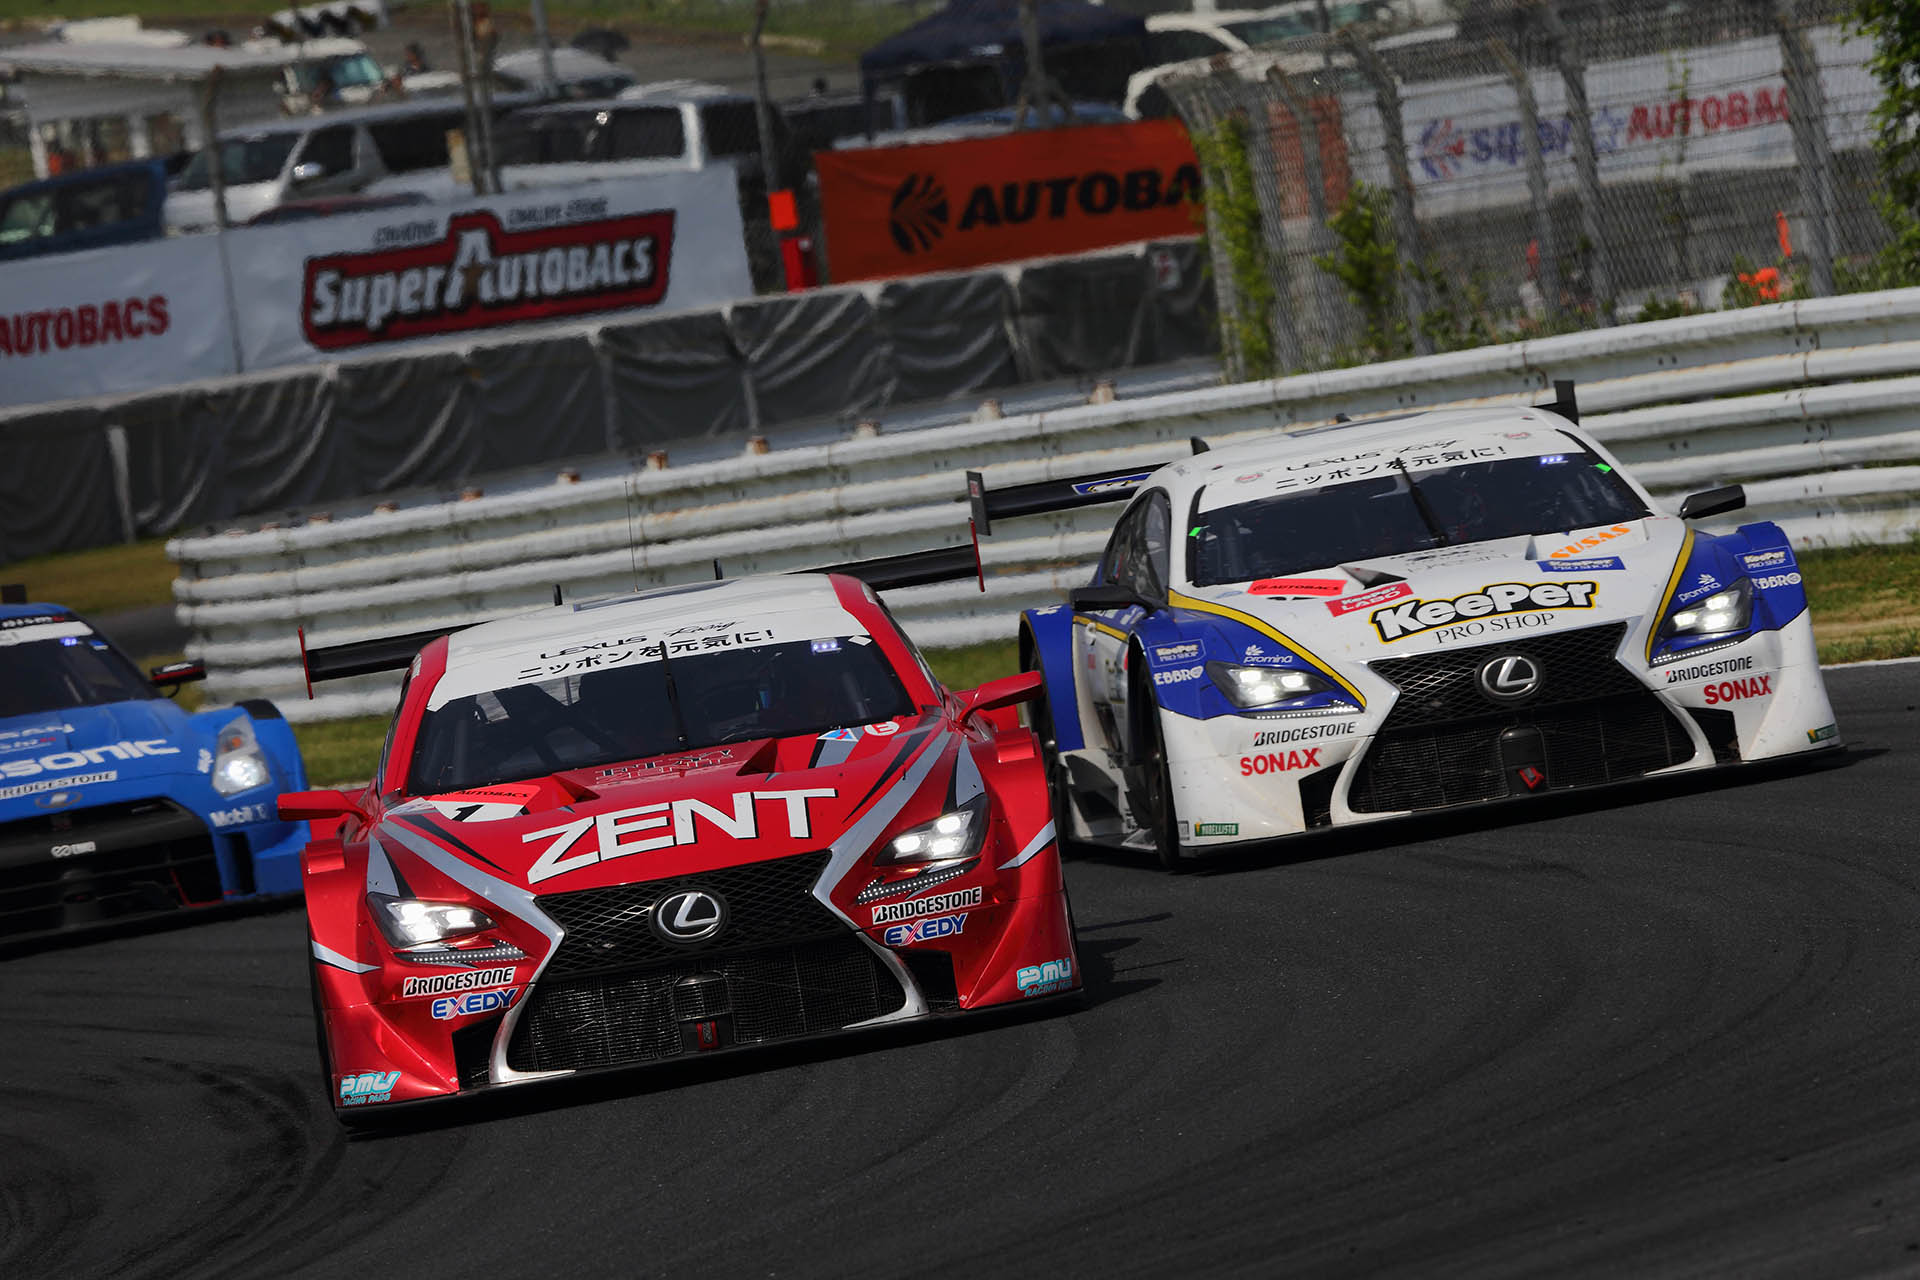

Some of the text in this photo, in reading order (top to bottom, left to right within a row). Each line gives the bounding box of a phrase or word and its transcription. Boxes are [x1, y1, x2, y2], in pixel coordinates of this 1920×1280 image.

[1678, 582, 1722, 602] promina
[1374, 582, 1595, 641] KeePer
[1435, 612, 1555, 644] PRO SHOP
[540, 634, 648, 660] LEXUS
[1243, 654, 1294, 664] promina
[1153, 665, 1204, 686] EBBRO
[1665, 655, 1753, 684] BRIDGESTONE
[1703, 674, 1773, 705] SONAX
[1254, 721, 1356, 747] BRIDGESTONE
[1239, 747, 1322, 777] SONAX
[0, 772, 113, 798] RIDGESTONE
[522, 787, 837, 885] ZENT
[873, 887, 982, 923] BRIDGESTONE
[884, 913, 967, 946] EXEDY
[404, 967, 515, 996] BRIDGESTONE
[432, 987, 519, 1019] EXEDY
